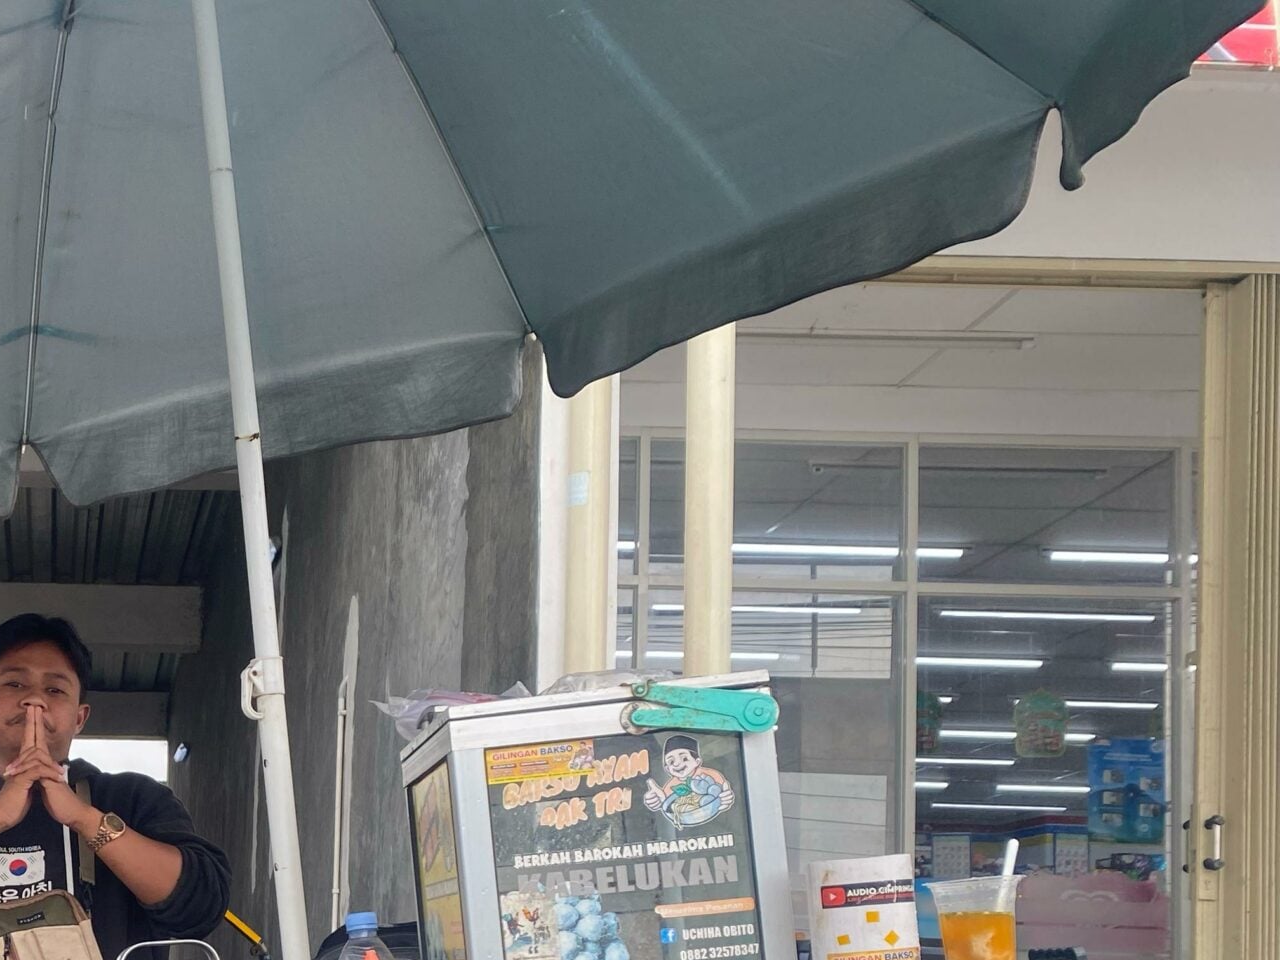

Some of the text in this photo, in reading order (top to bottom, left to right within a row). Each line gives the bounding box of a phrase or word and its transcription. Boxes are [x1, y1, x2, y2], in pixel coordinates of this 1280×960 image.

[492, 744, 574, 761] GILINGAN BAKSO
[514, 834, 734, 869] BERKAH BAROKAH MBAROKAHI
[517, 854, 739, 897] KABELUKAN
[846, 887, 876, 897] AUDIO
[682, 923, 754, 940] UCHIHA OBITO
[884, 951, 914, 960] BAKSO
